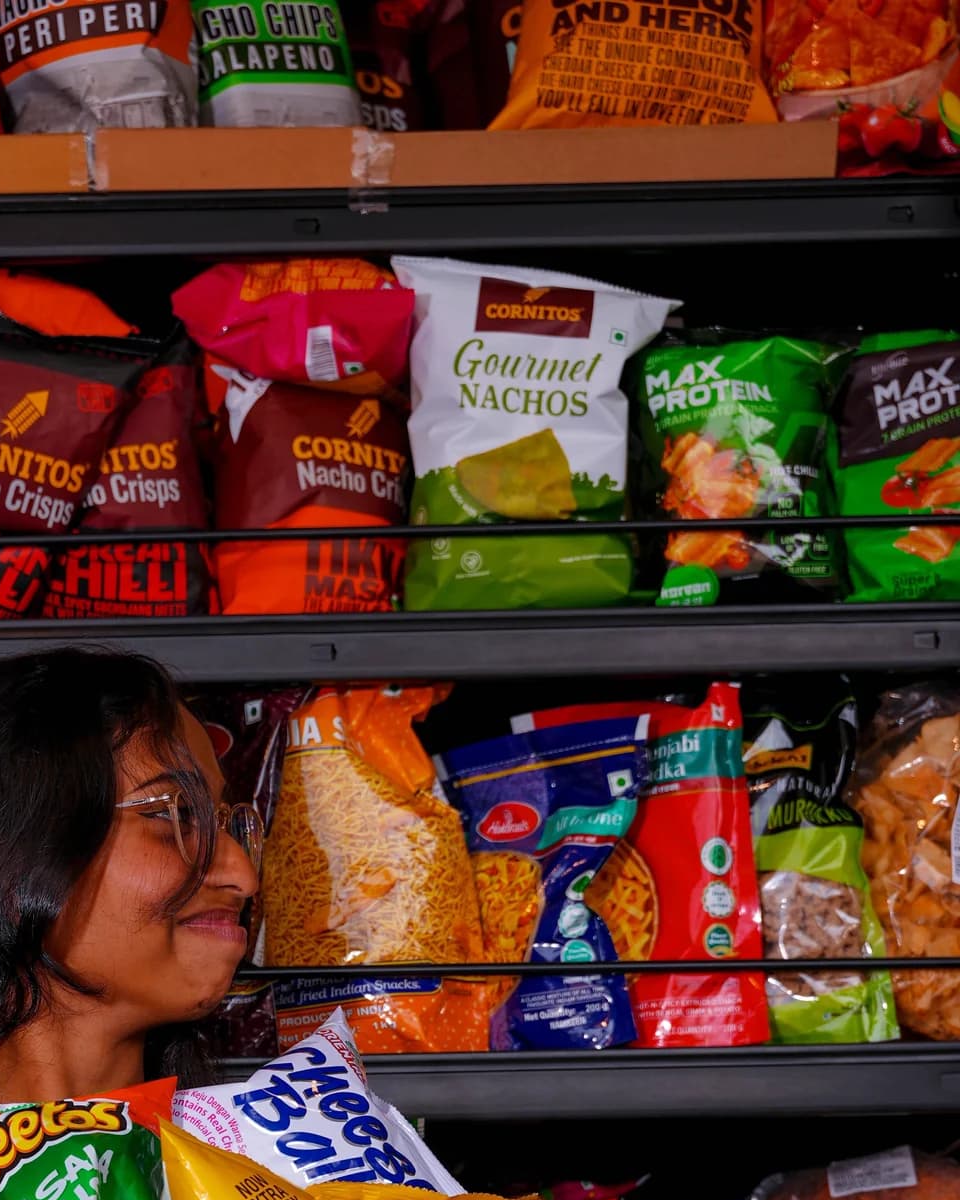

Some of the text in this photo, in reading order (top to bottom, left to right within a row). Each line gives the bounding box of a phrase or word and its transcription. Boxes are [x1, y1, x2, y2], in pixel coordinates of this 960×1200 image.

[4, 12, 66, 63] PERI
[79, 2, 157, 36] PERI
[267, 1, 338, 40] CHIPS
[551, 2, 629, 37] AND
[578, 38, 601, 58] THE
[605, 40, 653, 64] UNIQUE
[485, 303, 583, 323] CORNITOS
[453, 339, 603, 383] Gourmet
[645, 355, 726, 396] MAX
[458, 383, 588, 416] NACHOS
[648, 379, 772, 419] PROTEIN
[873, 357, 955, 408] MAX
[877, 384, 960, 430] PROT
[292, 435, 405, 473] CORNIT
[110, 473, 180, 509] Crisps
[296, 460, 367, 494] Nacho
[4, 478, 74, 529] Crisps
[331, 982, 371, 997] Indian
[374, 979, 421, 991] Snacks.
[181, 1112, 212, 1137] Artificial
[207, 1096, 231, 1120] Dengan
[228, 1118, 243, 1143] Warna
[208, 1114, 227, 1134] Real
[235, 1173, 267, 1200] NOW
